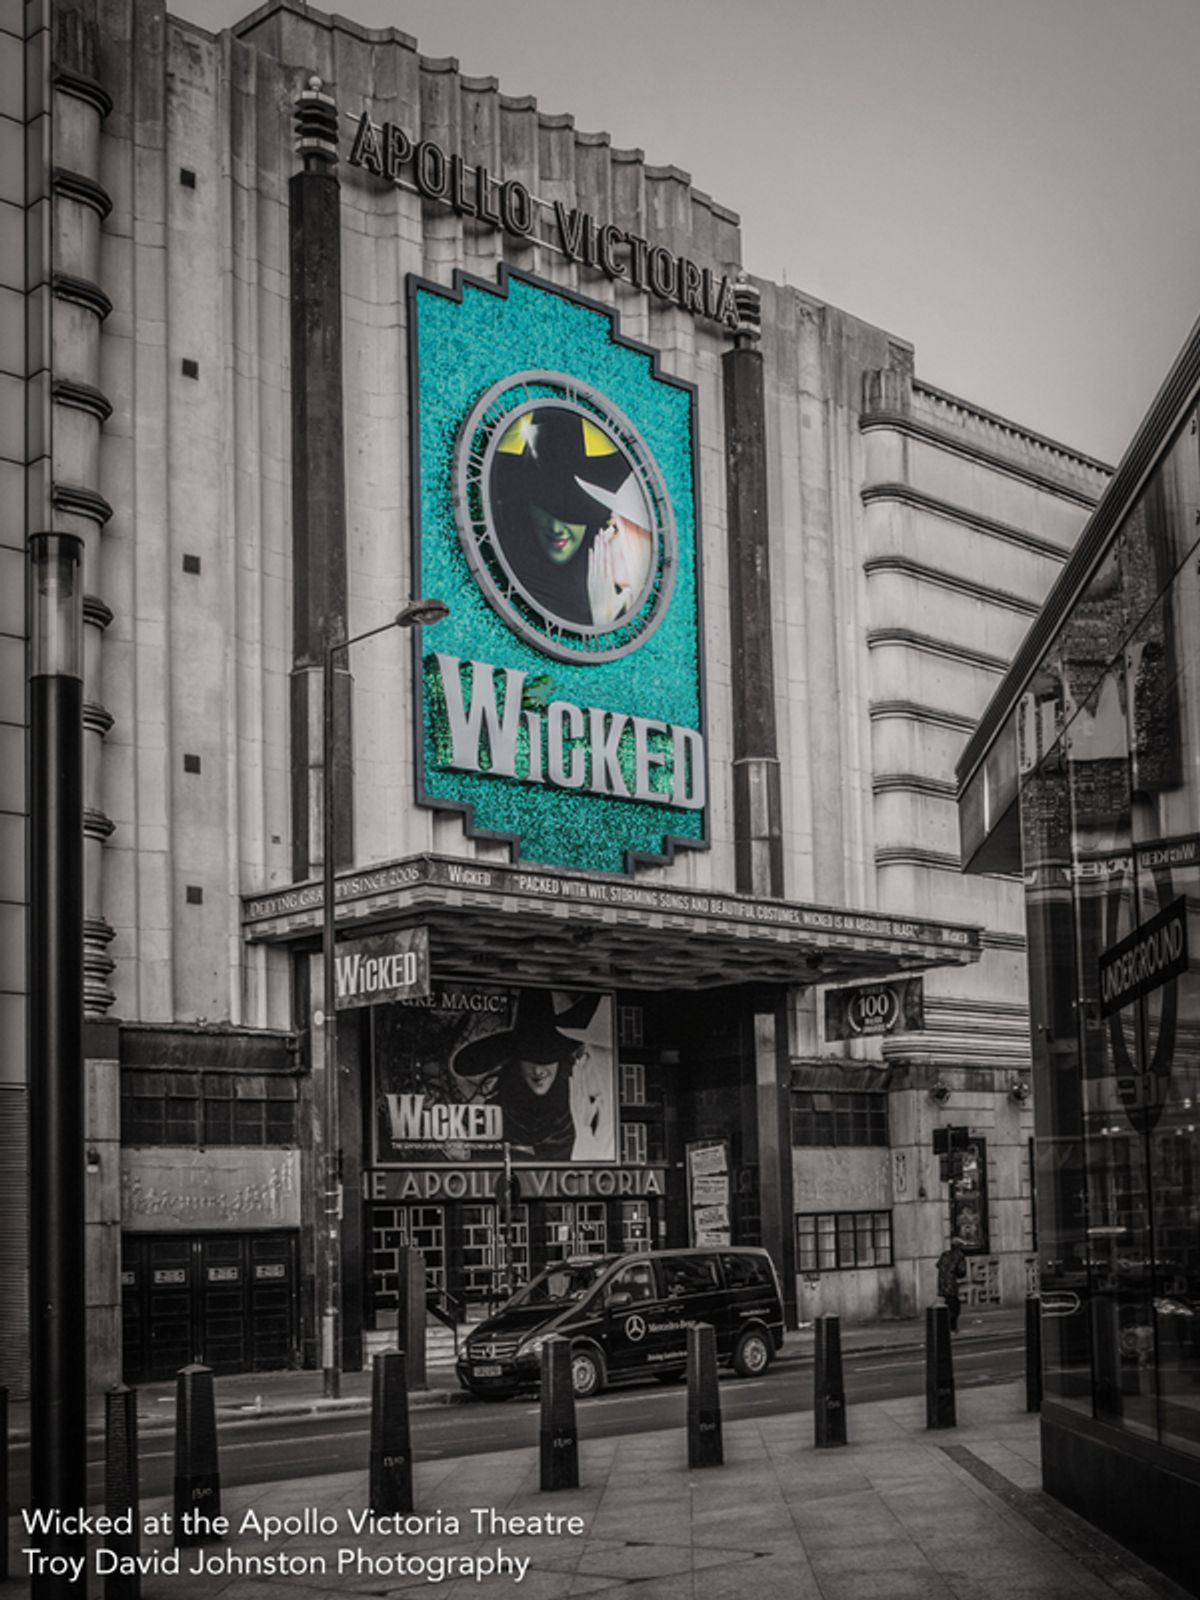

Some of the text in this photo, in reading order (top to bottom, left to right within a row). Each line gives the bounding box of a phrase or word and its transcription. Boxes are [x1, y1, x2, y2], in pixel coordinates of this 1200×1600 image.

[347, 111, 741, 331] APOLLO VICTORIA
[351, 873, 389, 895] SINCE
[561, 881, 588, 897] WITH
[691, 898, 709, 912] AND
[1101, 917, 1184, 1003] UNDERGROUND
[857, 993, 890, 1018] 100
[399, 1171, 503, 1200] APOLL
[530, 1169, 664, 1198] VICTORIA
